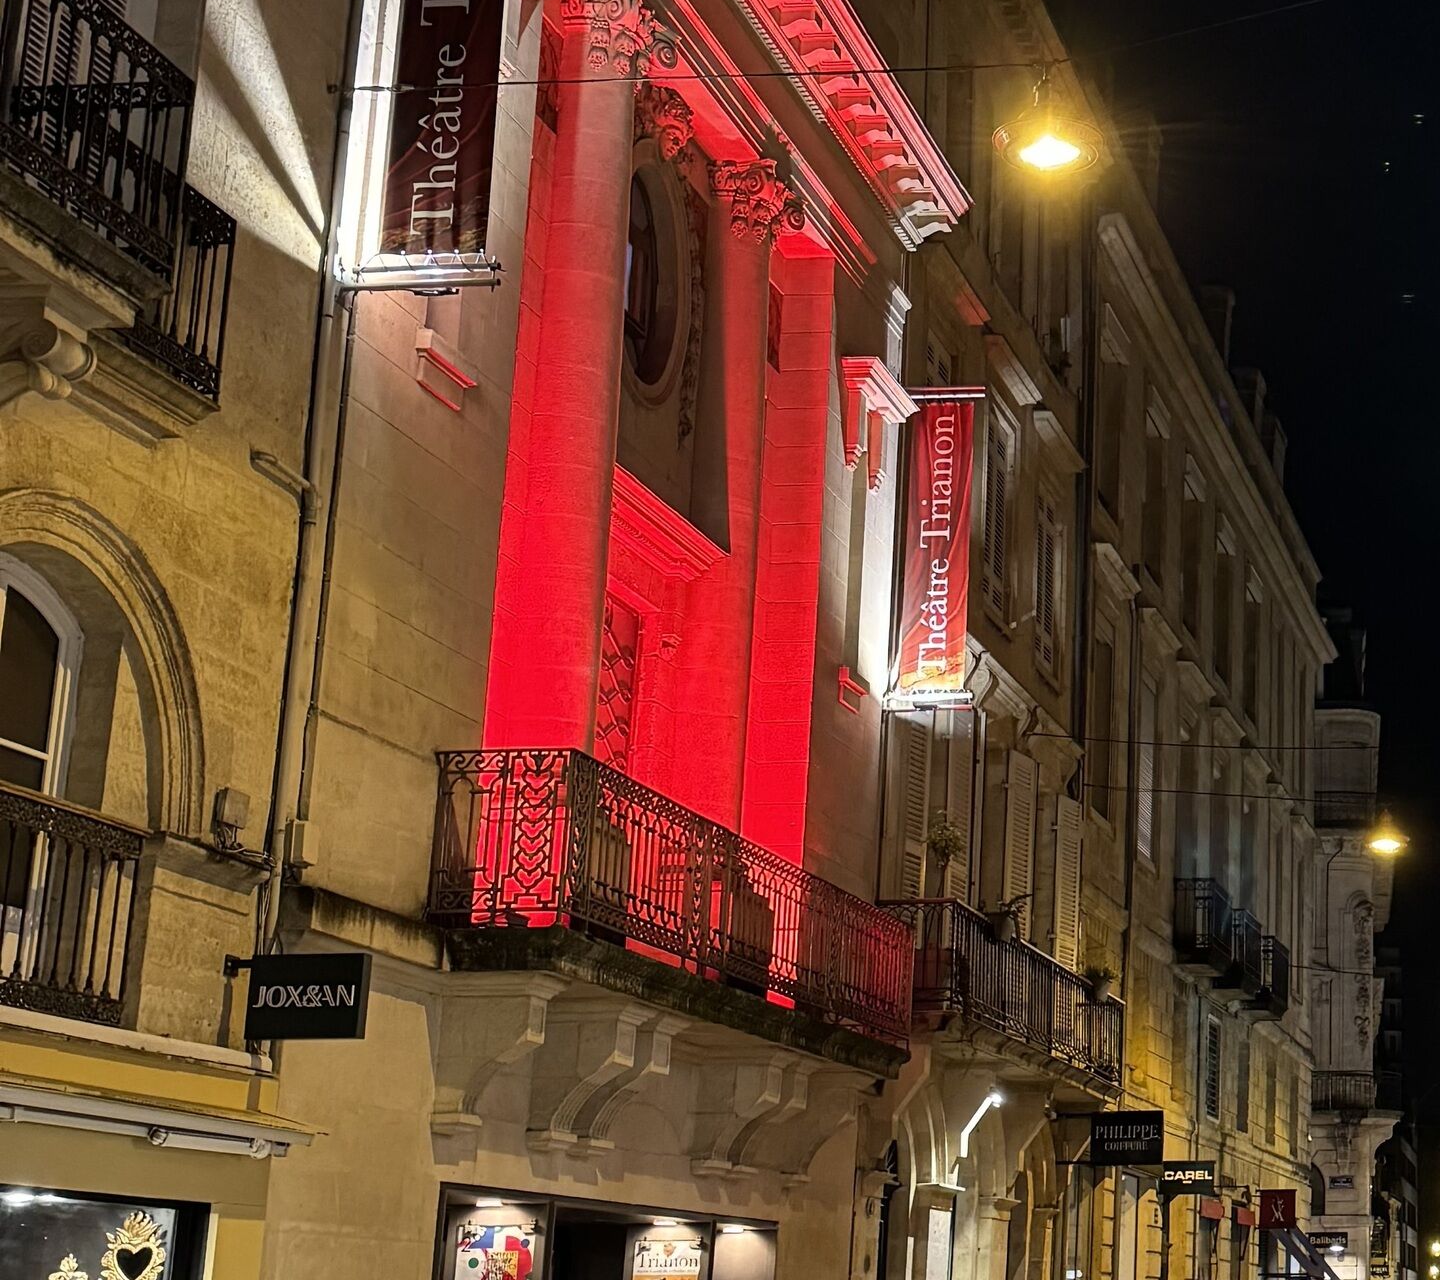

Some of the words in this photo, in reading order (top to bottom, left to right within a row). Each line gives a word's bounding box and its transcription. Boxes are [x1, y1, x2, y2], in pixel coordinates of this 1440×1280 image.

[410, 43, 466, 235] Théâtre
[919, 414, 955, 549] Trianon
[917, 557, 949, 678] Théâtre
[252, 984, 356, 1008] JOX&AN
[1095, 1124, 1161, 1140] PHILIPPE
[1104, 1140, 1149, 1151] COIFFURE
[1164, 1170, 1213, 1181] CAREL
